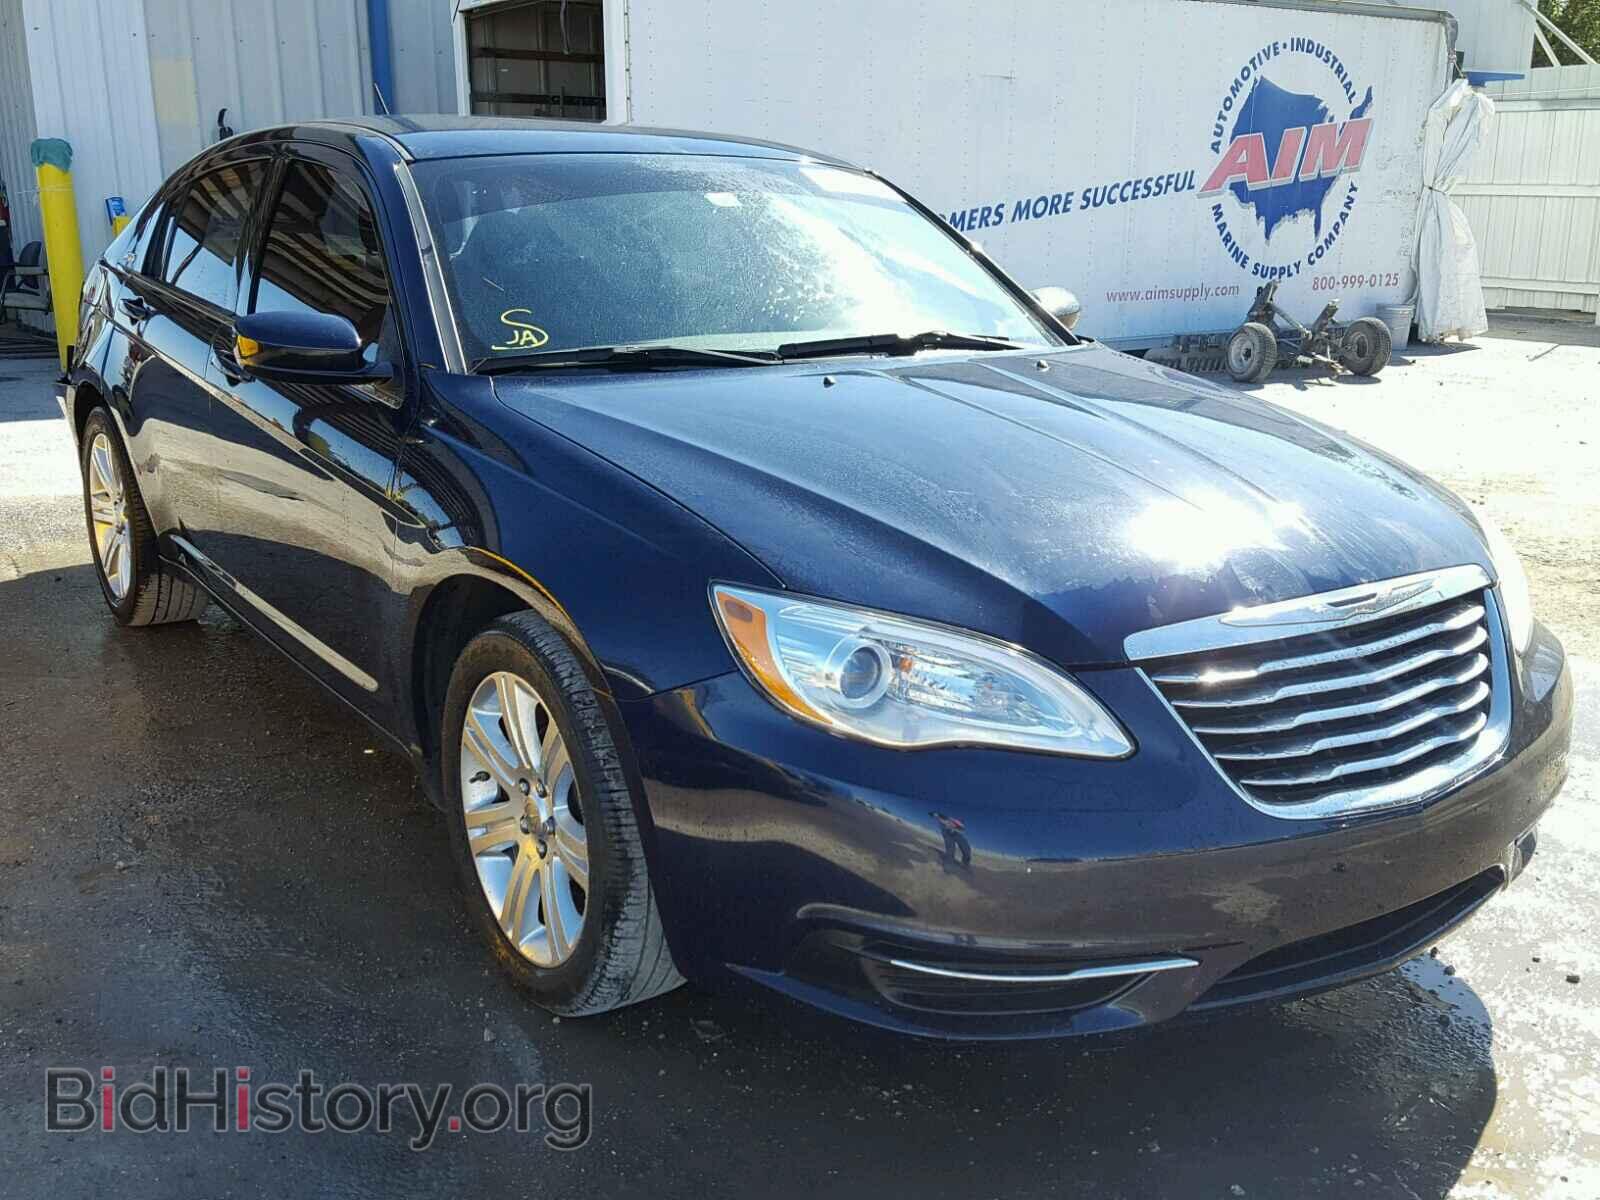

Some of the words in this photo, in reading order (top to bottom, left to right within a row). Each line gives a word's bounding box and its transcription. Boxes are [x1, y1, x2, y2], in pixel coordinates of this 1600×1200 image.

[1210, 41, 1280, 155] AUTOMOTIVE
[1290, 37, 1357, 104] INDUSTRIAL
[1197, 117, 1373, 199] AIM
[939, 203, 1005, 232] MERS
[1010, 191, 1075, 223] MORE
[1079, 169, 1196, 210] SUCCESSFUL
[1211, 202, 1251, 270] MARINE
[1251, 260, 1301, 280] SUPPLY
[1307, 180, 1359, 267] COMPANY
[1105, 281, 1241, 303] www.aimsupply.com
[1311, 273, 1399, 291] 800-999-0125
